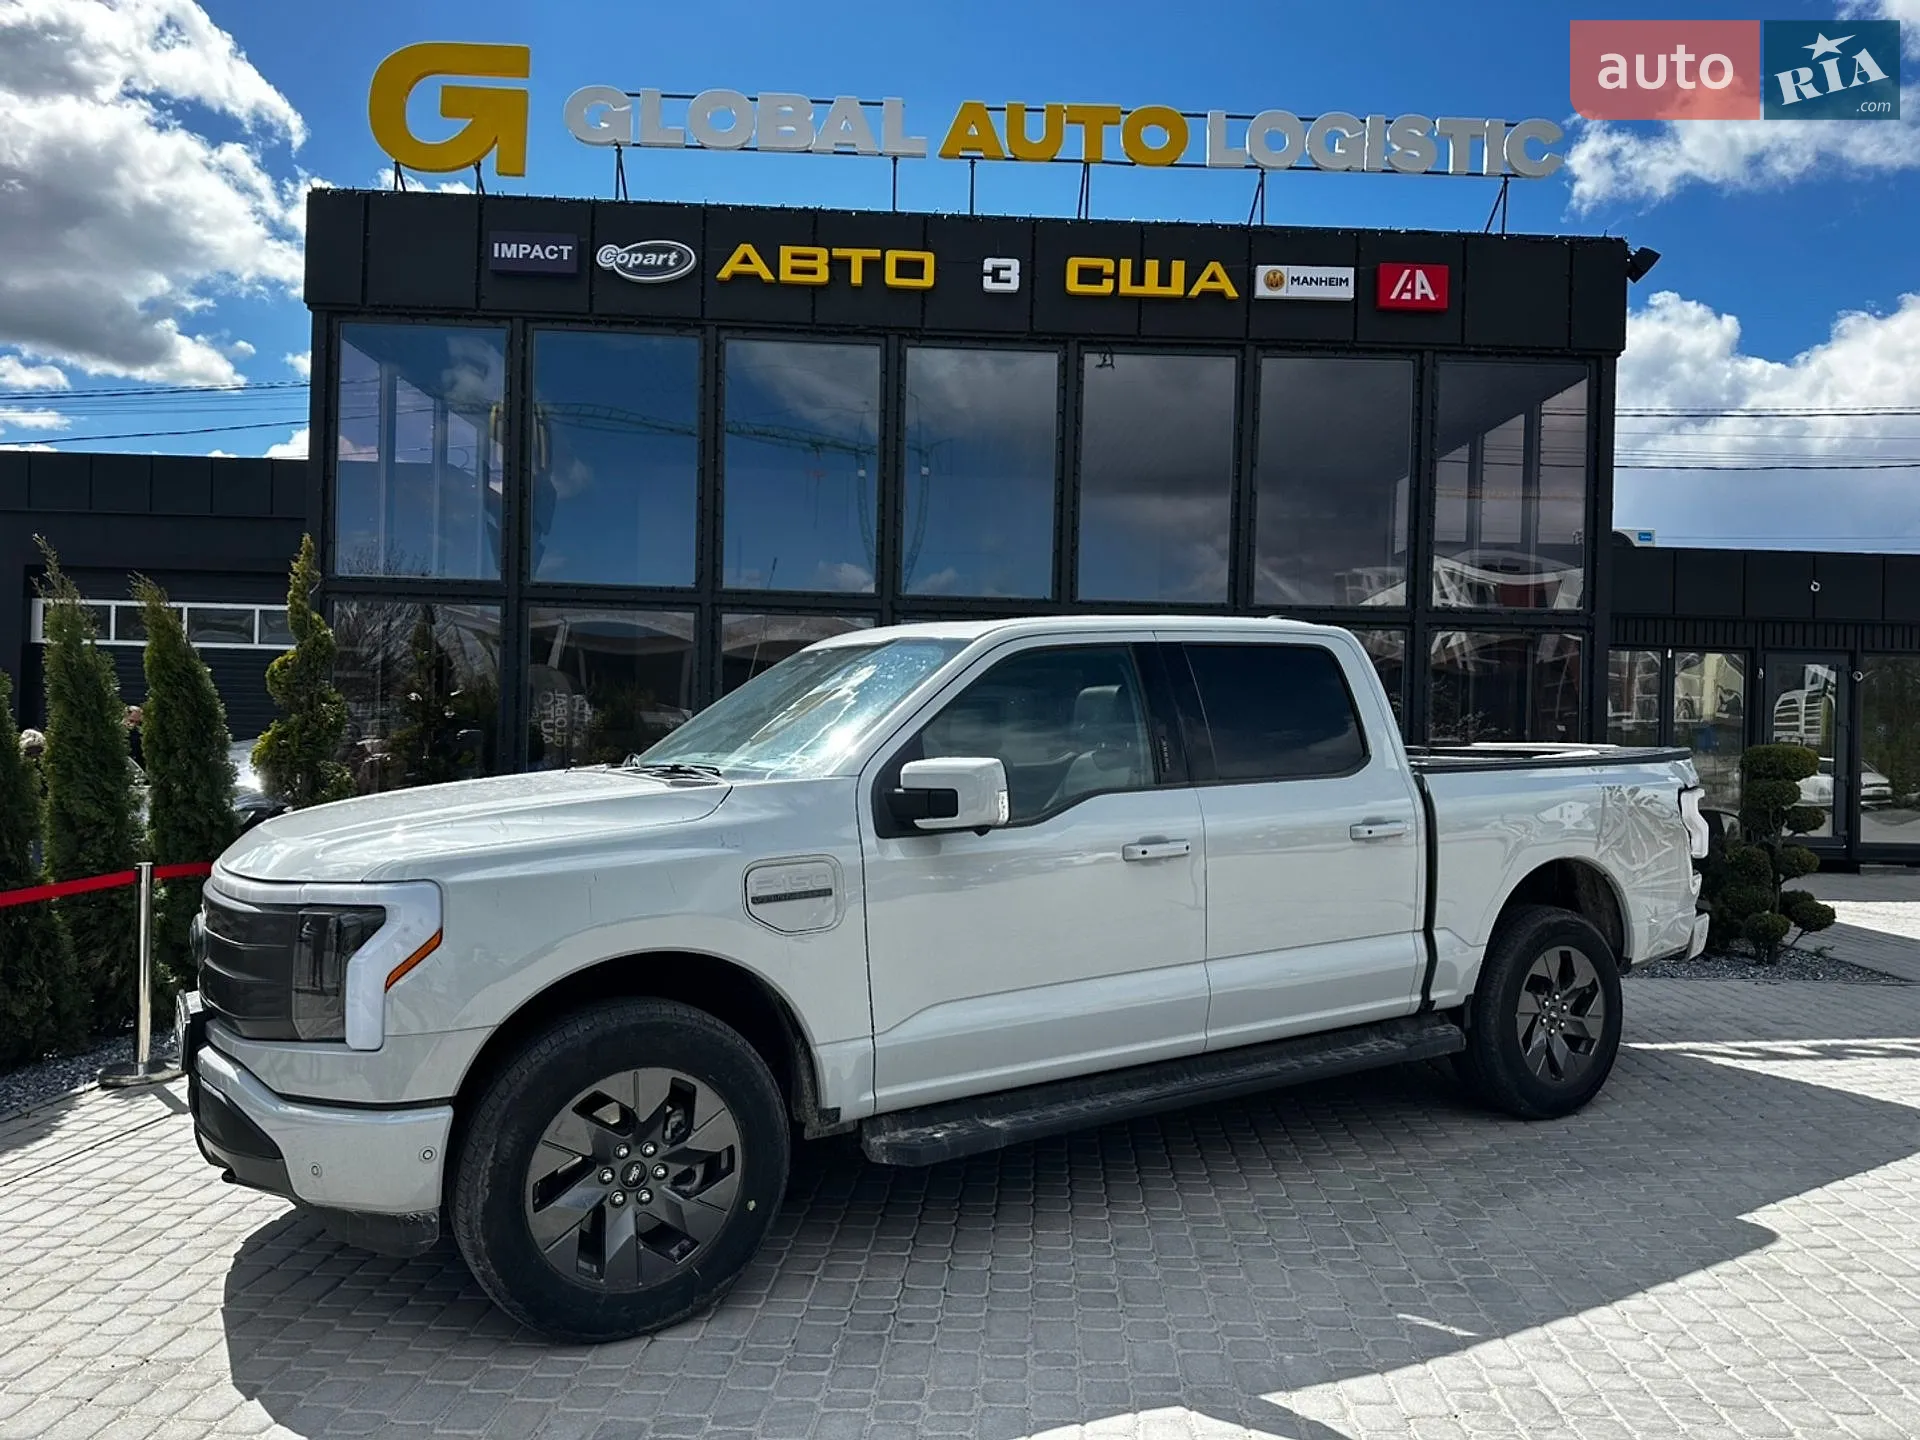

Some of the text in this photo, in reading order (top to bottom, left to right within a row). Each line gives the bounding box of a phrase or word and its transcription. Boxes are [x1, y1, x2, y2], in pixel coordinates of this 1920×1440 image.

[563, 84, 1565, 179] GLOBAL AUTO LOGISTIC
[493, 243, 573, 261] IMPACT
[599, 247, 679, 268] Copart
[716, 243, 935, 290] АВТО
[1065, 256, 1240, 300] США
[1290, 275, 1350, 287] MANHEIM
